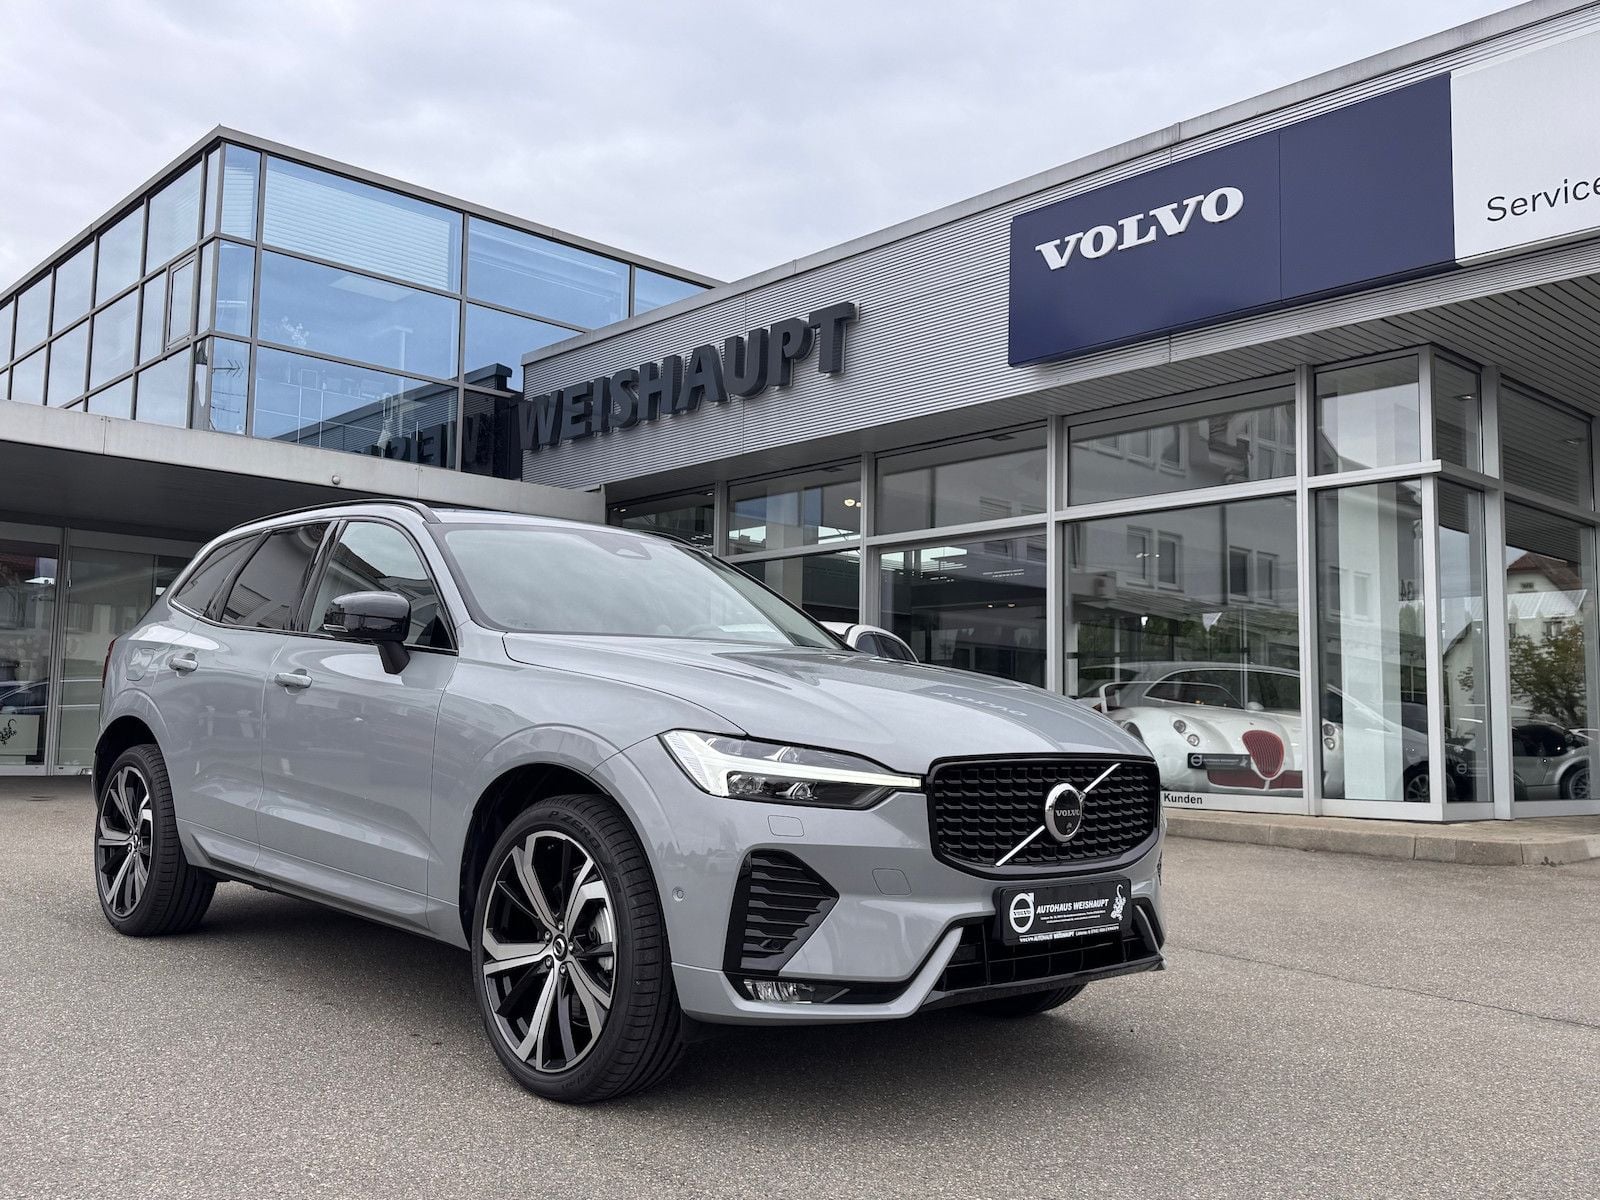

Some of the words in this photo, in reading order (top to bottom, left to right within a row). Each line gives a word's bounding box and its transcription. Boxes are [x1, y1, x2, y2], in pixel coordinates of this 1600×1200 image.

[1034, 186, 1245, 271] VOLVO
[518, 301, 856, 451] WEISHAUPT
[1163, 793, 1203, 804] Kunden
[548, 810, 559, 818] P
[560, 814, 601, 849] ZERO
[1036, 903, 1073, 914] AUTOHAUS
[1073, 899, 1110, 910] WEISHAUPT
